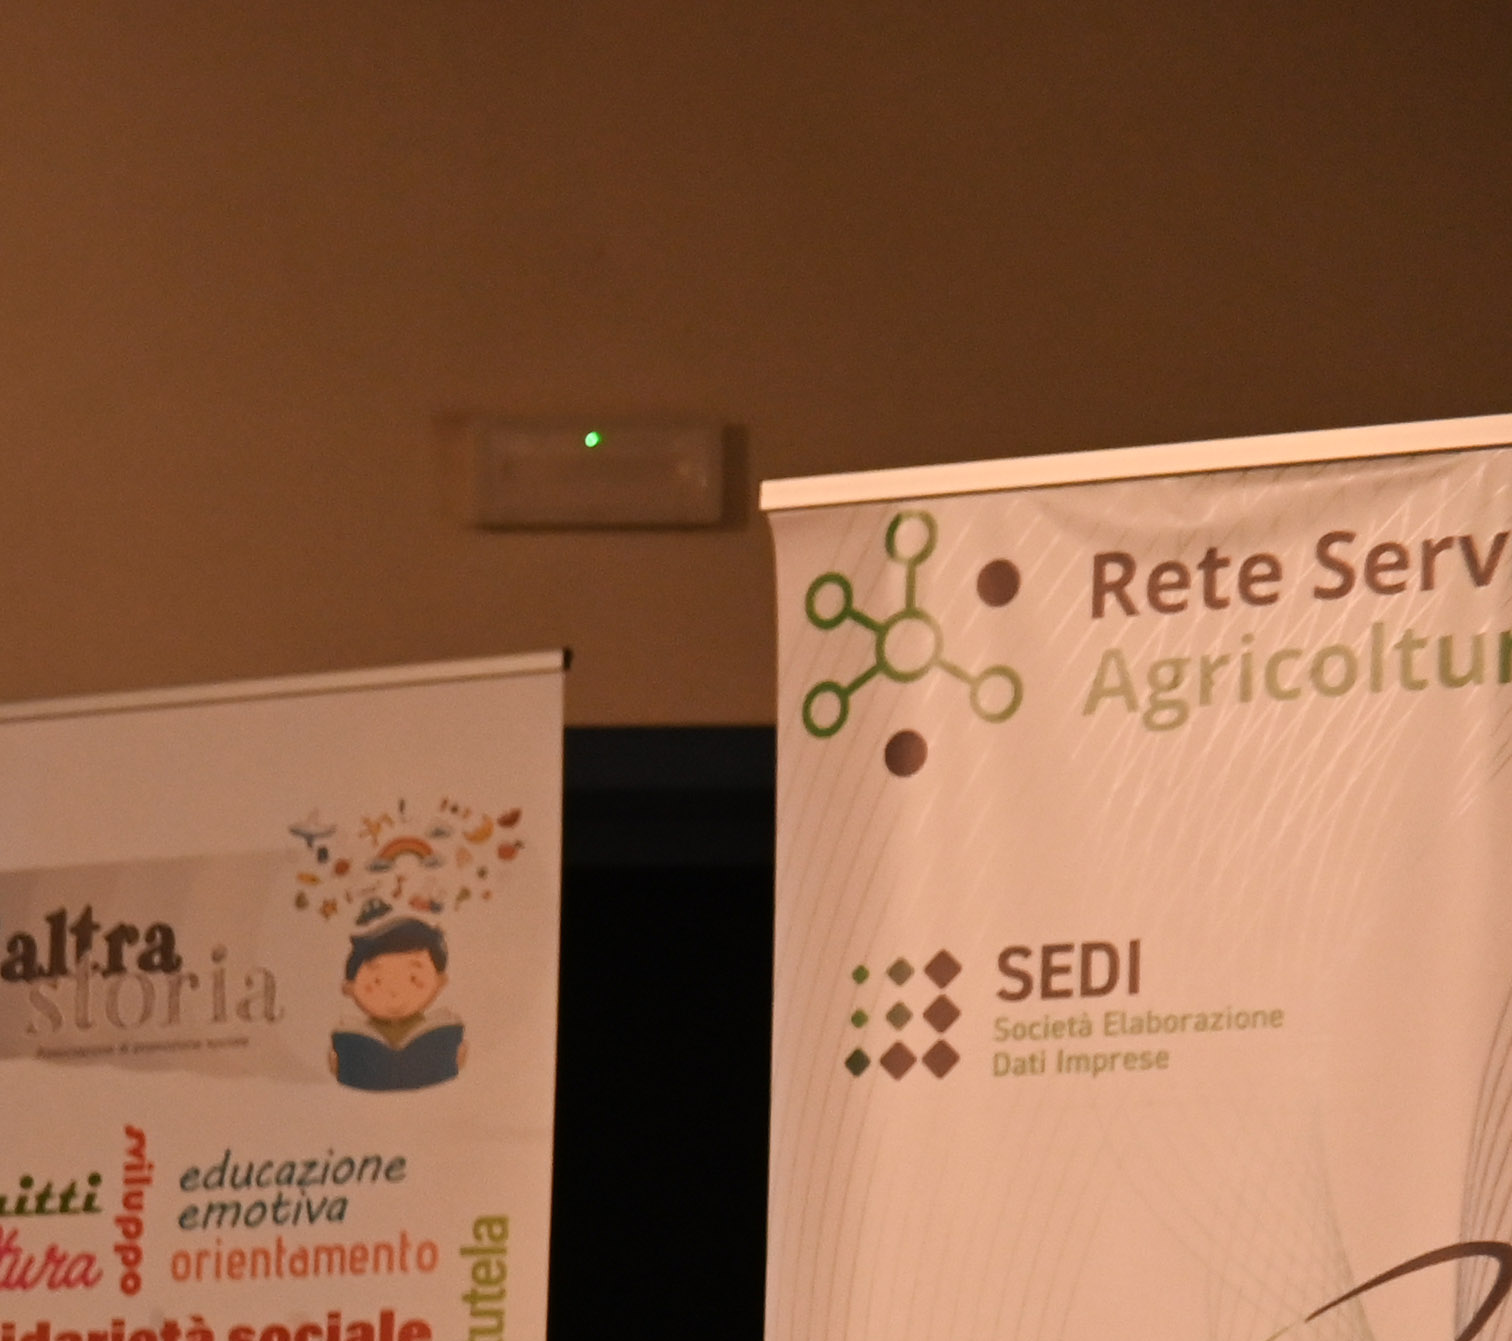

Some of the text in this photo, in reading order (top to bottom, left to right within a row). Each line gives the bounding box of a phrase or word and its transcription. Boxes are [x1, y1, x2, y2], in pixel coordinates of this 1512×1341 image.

[1090, 529, 1510, 620] Rete Serv
[26, 945, 284, 1035] storia
[996, 939, 1142, 1003] SEDI
[993, 1003, 1285, 1044] Società Elaborazione
[992, 1045, 1171, 1079] Dati Imprese
[178, 1147, 407, 1194] educazione
[177, 1189, 349, 1231] emotiva
[169, 1228, 440, 1283] orientamento
